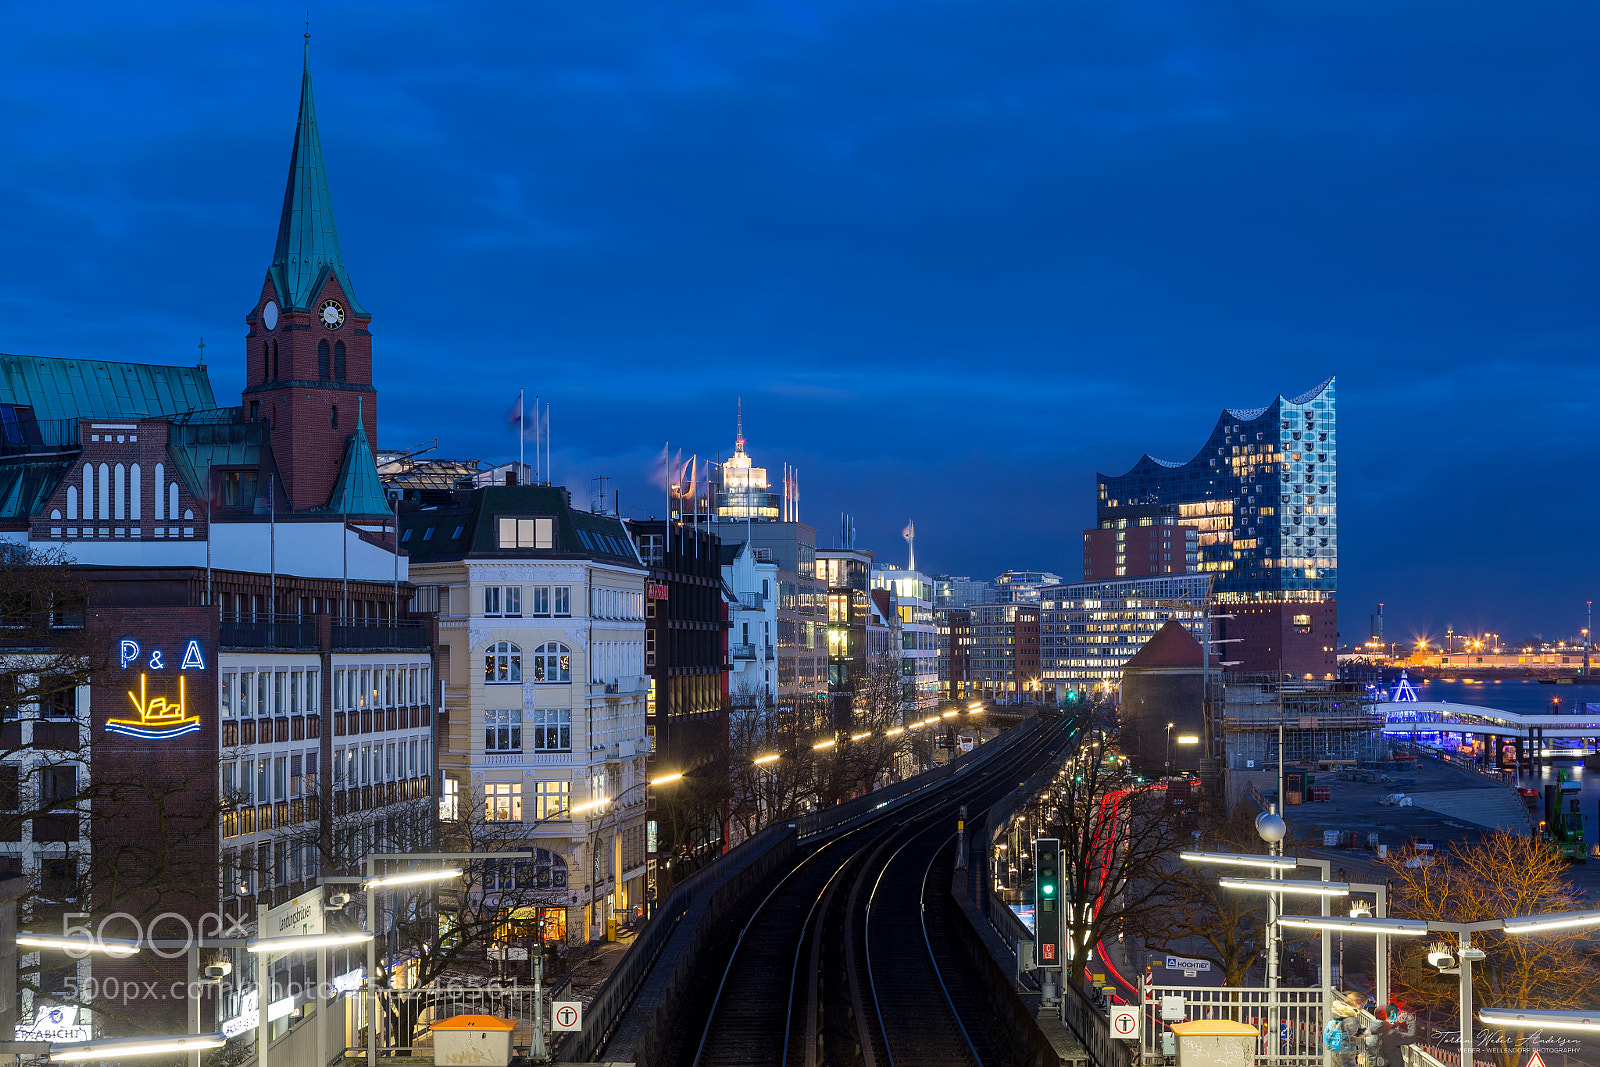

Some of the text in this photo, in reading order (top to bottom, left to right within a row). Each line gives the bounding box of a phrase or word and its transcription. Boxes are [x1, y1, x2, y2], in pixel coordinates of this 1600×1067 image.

[121, 640, 205, 670] P & A
